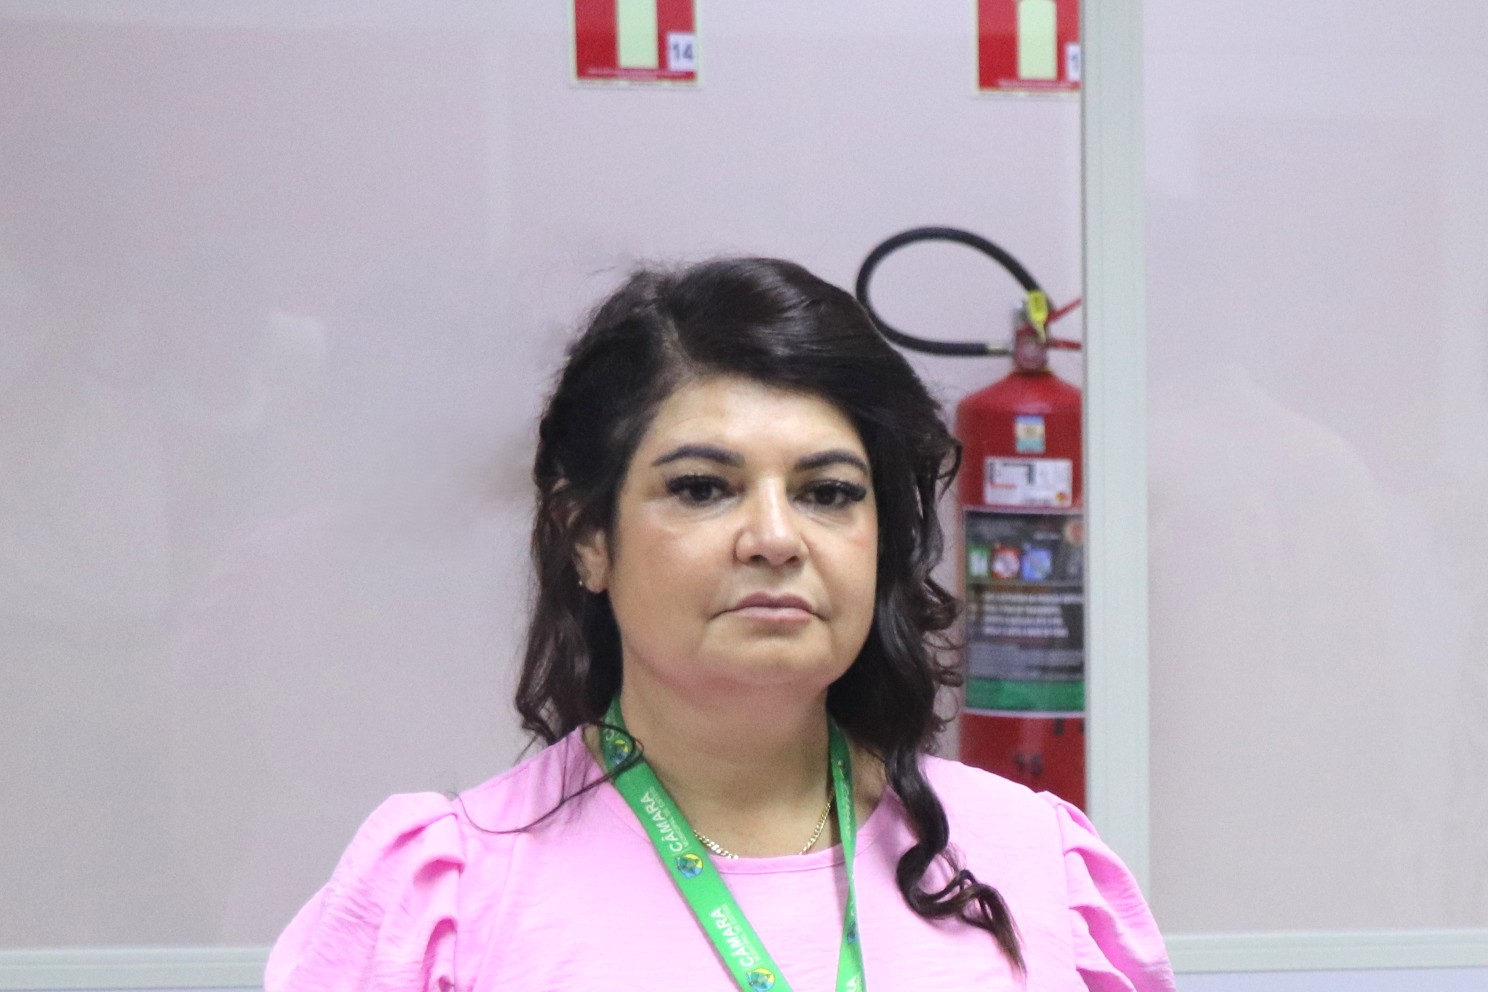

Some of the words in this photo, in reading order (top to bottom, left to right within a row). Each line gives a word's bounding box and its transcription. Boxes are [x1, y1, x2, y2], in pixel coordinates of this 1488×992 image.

[672, 42, 694, 62] 14
[641, 791, 683, 852] CÂMARA
[710, 907, 755, 967] CÂMARA
